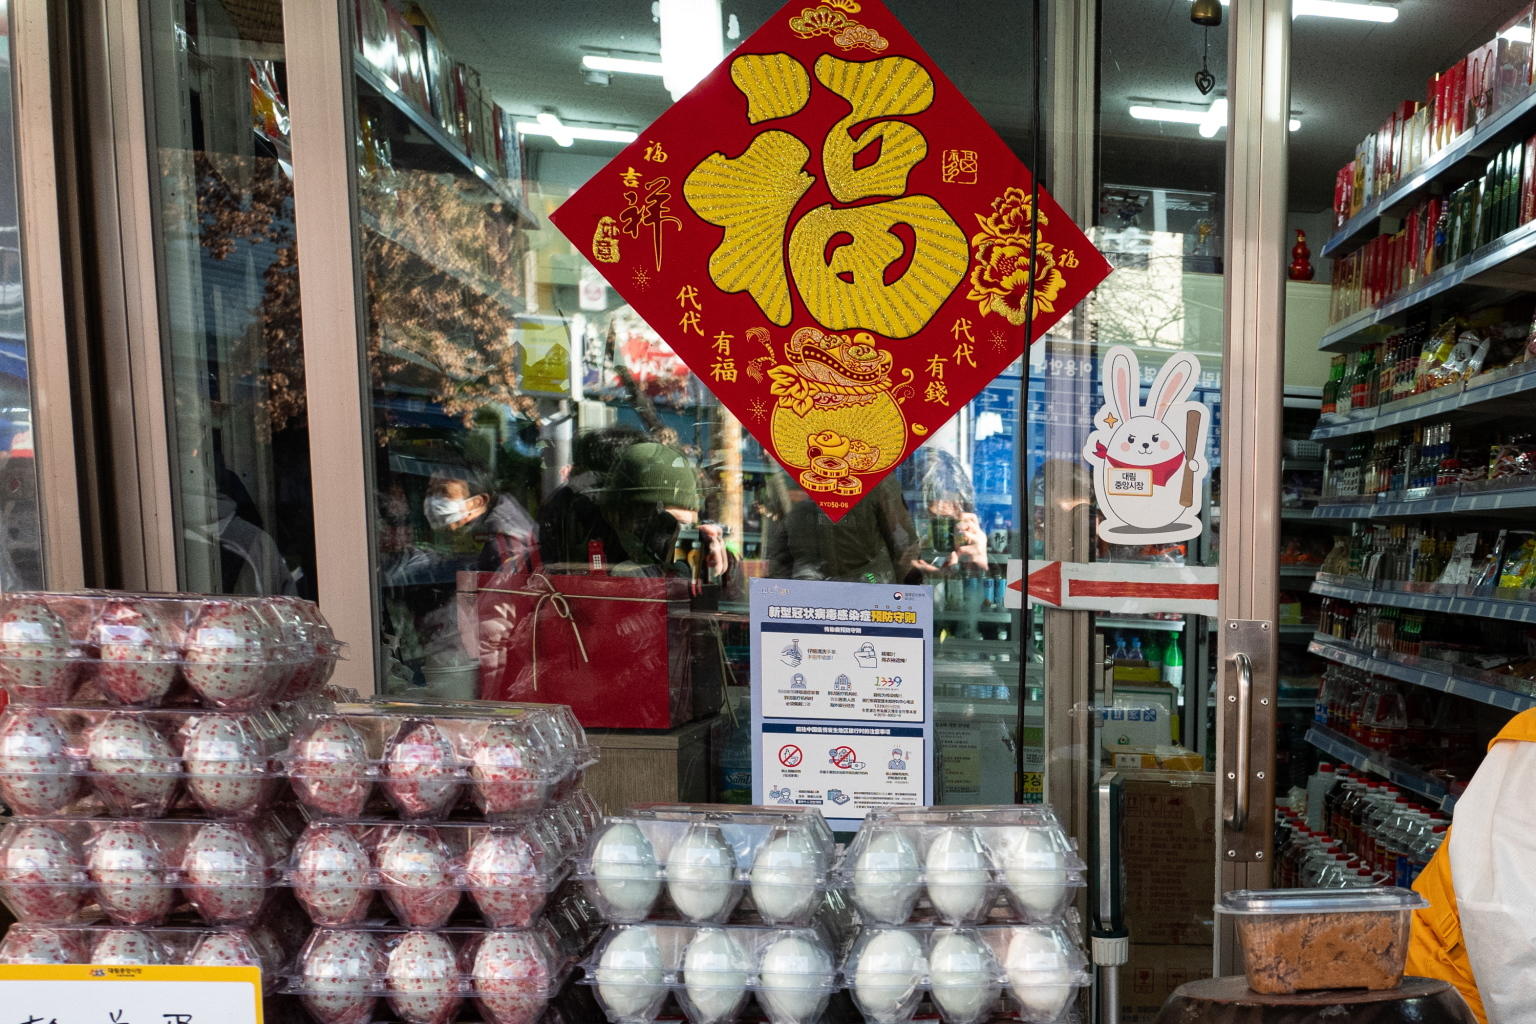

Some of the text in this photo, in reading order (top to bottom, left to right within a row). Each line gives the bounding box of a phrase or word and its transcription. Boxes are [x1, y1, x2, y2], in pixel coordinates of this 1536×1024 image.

[643, 140, 669, 164] 福
[682, 52, 970, 339] 福
[1057, 248, 1081, 269] 福
[675, 284, 705, 337] 代代
[709, 330, 739, 384] 有福
[950, 316, 978, 369] 代代
[923, 353, 950, 408] 有錢
[1114, 481, 1144, 491] 중앙시장
[1121, 471, 1137, 481] 대림
[874, 676, 903, 689] 1339
